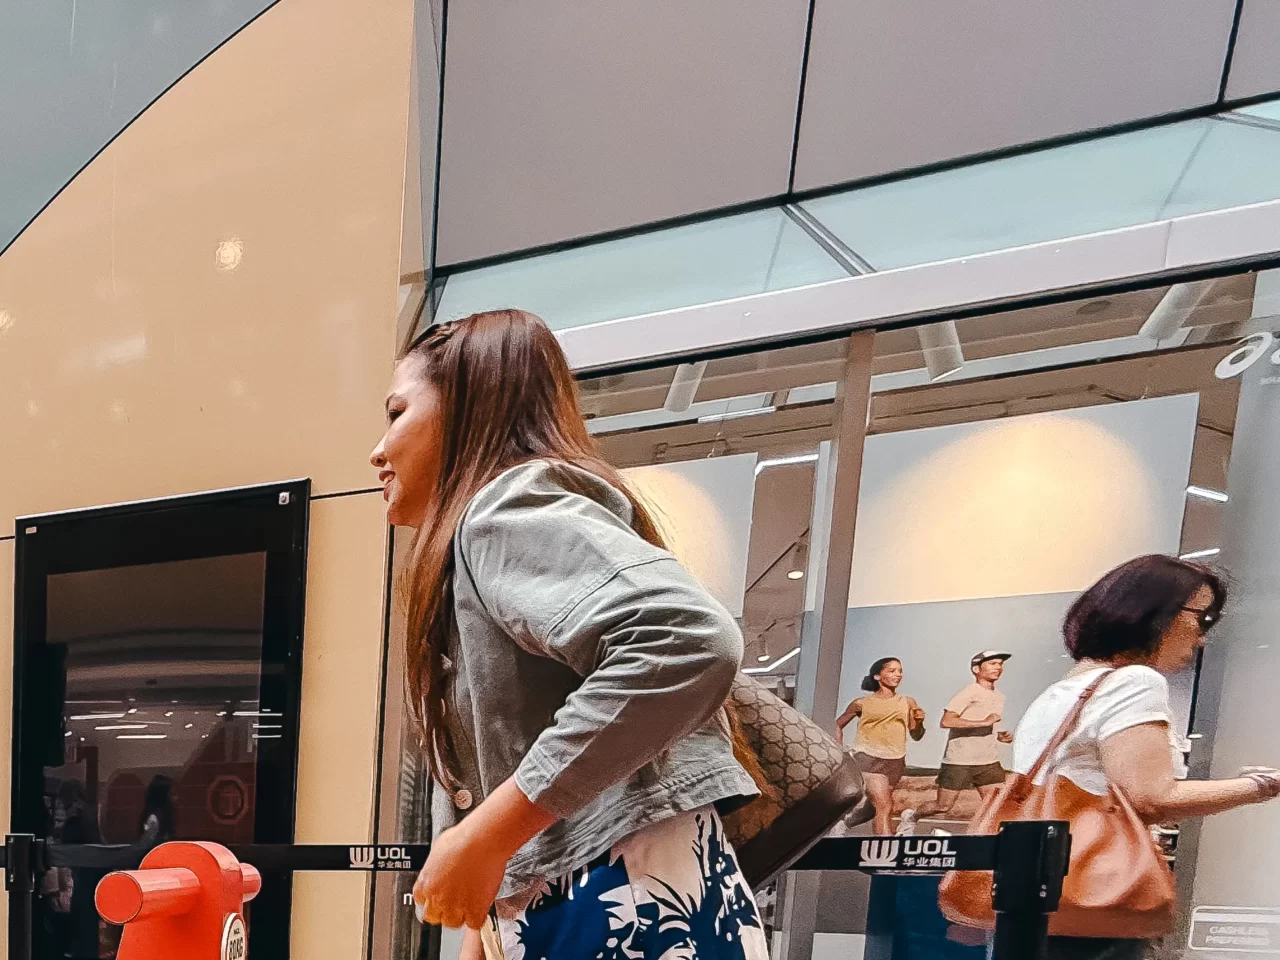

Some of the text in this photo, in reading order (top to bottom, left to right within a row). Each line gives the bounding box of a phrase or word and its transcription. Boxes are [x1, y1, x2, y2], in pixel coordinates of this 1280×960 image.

[377, 847, 411, 860] UOL
[904, 840, 957, 855] UOL
[902, 857, 956, 868] 华业集团
